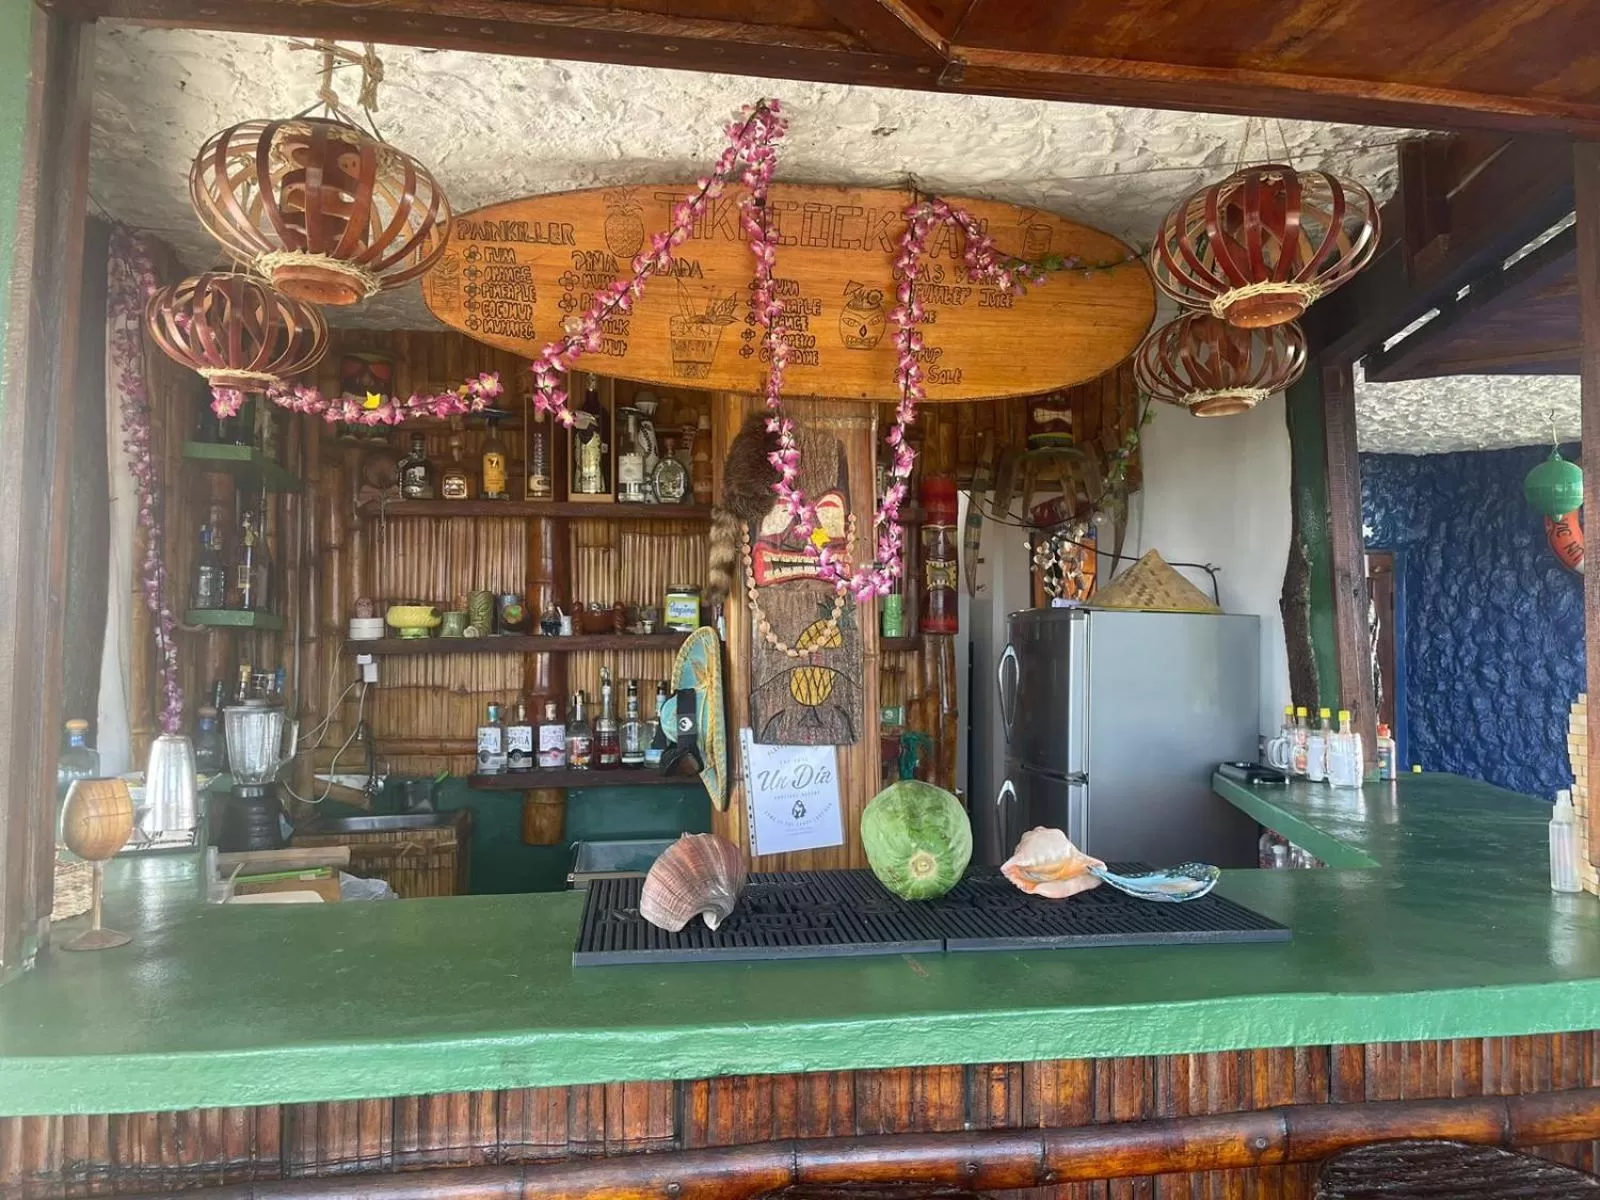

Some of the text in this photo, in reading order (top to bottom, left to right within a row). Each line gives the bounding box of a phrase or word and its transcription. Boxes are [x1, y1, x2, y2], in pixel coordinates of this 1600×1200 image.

[457, 219, 576, 246] PAINKILLER
[771, 278, 800, 297] UM
[482, 299, 533, 321] COCONUT
[766, 314, 809, 331] RANGE
